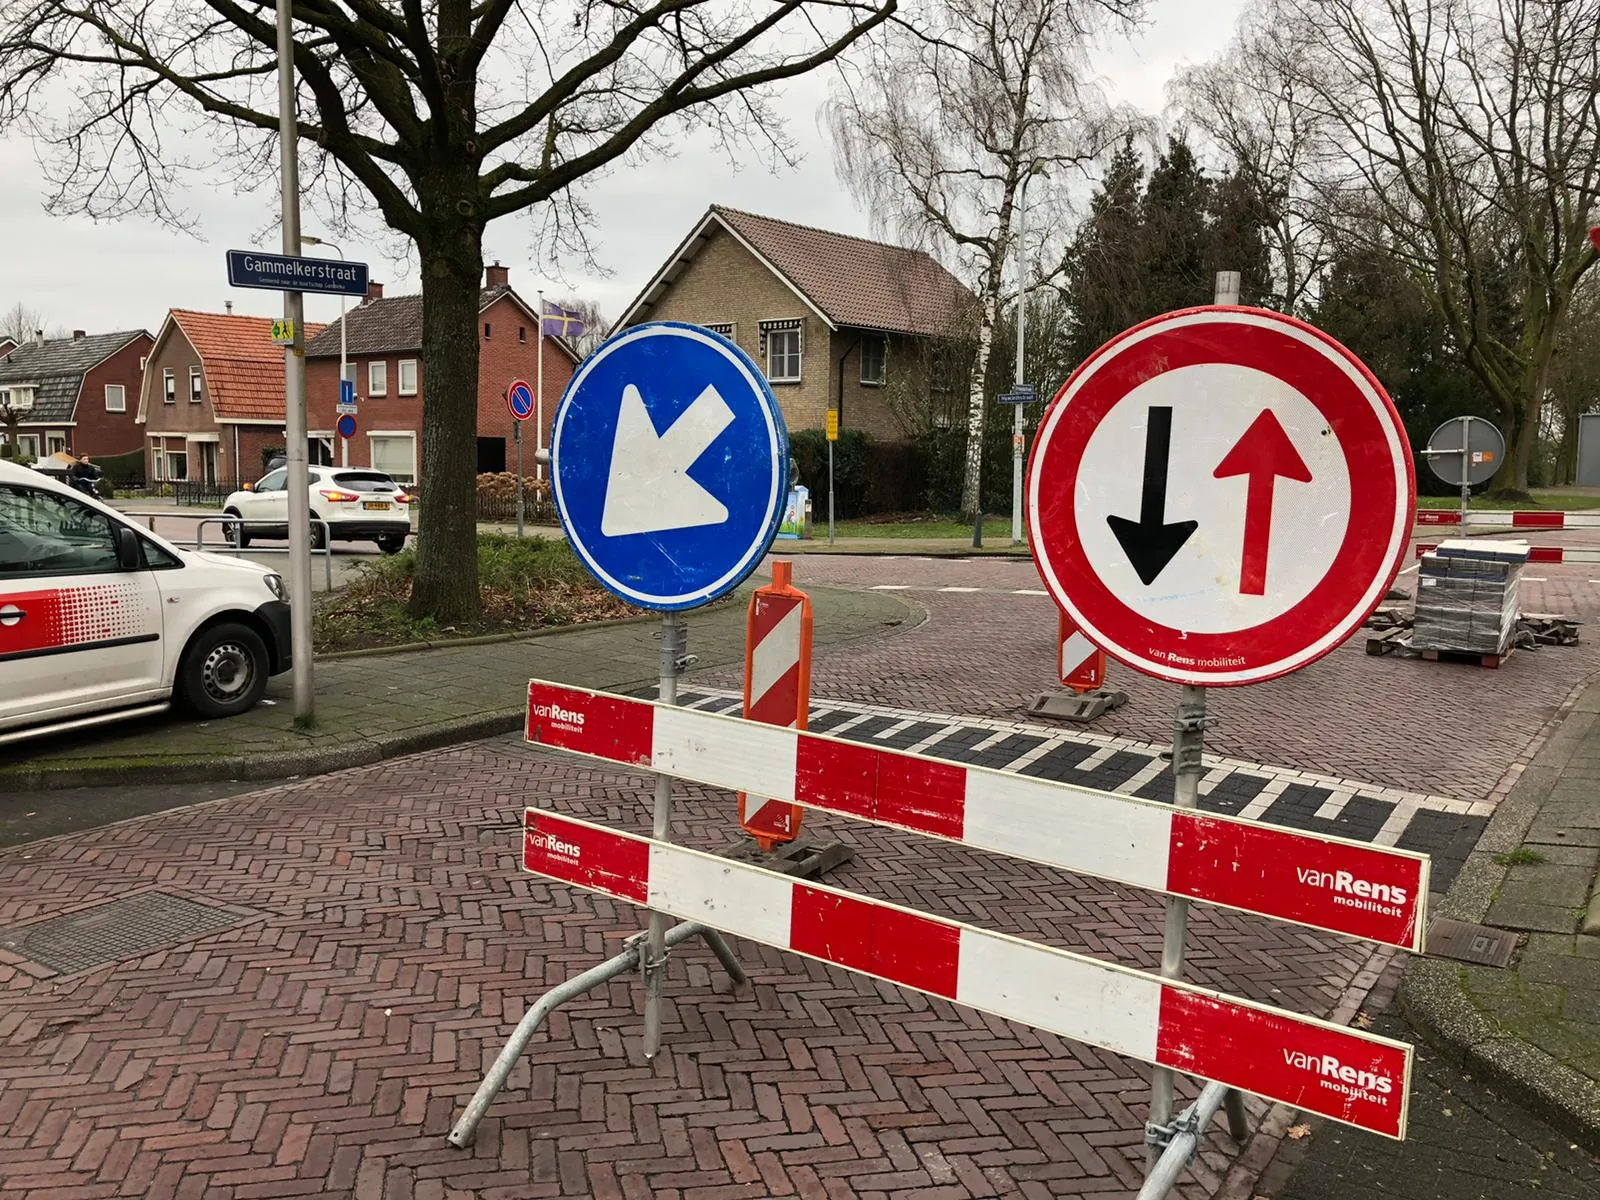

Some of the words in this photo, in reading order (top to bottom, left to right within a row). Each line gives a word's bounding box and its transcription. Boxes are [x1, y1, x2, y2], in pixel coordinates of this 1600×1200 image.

[244, 256, 356, 281] Gammelkerstraat
[1149, 648, 1166, 659] van
[1167, 652, 1195, 666] Rens
[1197, 656, 1246, 667] mobiliteit
[533, 704, 585, 725] vanRens
[551, 721, 583, 734] mobiliteit
[530, 834, 581, 858] vanRens
[547, 852, 579, 866] mobiliteit
[1296, 867, 1407, 905] vanRens
[1333, 895, 1402, 918] mobiliteit
[1283, 1048, 1392, 1094] vanRens
[1320, 1080, 1388, 1106] mobiliteit
